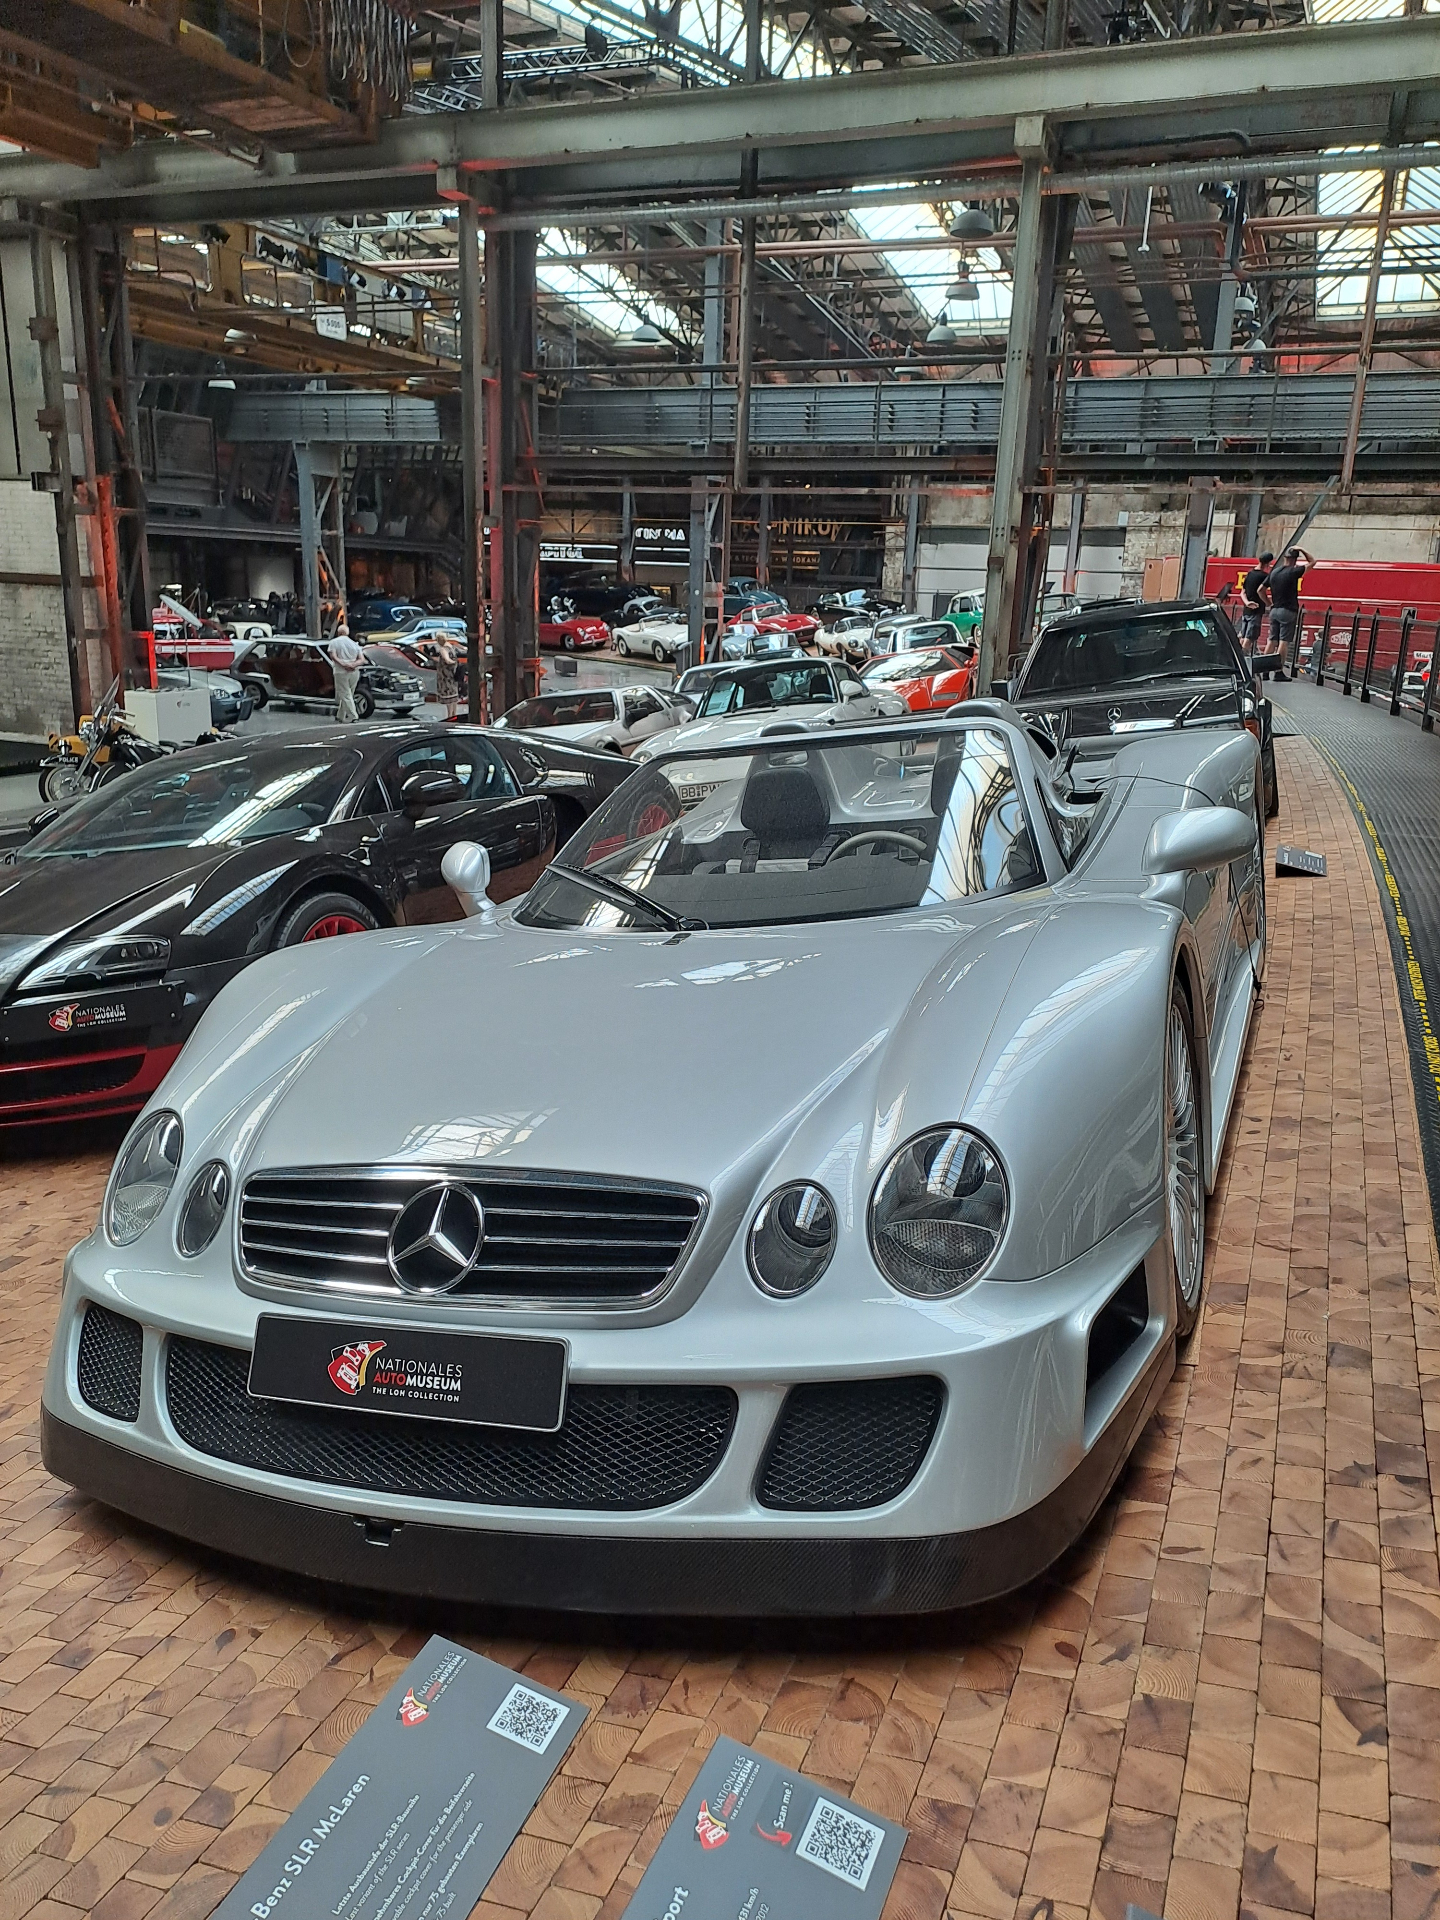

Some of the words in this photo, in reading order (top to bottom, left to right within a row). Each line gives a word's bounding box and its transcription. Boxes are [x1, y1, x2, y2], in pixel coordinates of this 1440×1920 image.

[681, 787, 696, 799] BB
[76, 1004, 125, 1016] NATIONALES
[77, 1011, 126, 1024] AUTOMUSEUM
[98, 1017, 126, 1025] COLLECTION
[373, 1371, 462, 1391] AUTOMUSEUM
[375, 1356, 463, 1378] NATIONALES
[372, 1386, 388, 1396] THE
[389, 1388, 407, 1398] LOH
[408, 1390, 460, 1402] COLLECTION
[417, 1650, 455, 1697] NATIONALES
[425, 1654, 463, 1701] AUTOMUSEUM
[432, 1692, 441, 1703] THE
[447, 1658, 468, 1684] COLLECTION
[711, 1754, 748, 1812] NATIONALES
[721, 1758, 755, 1817] AUTOMUSEUM
[730, 1808, 739, 1820] THE
[742, 1763, 761, 1799] COLLECTION
[284, 1838, 320, 1876] SLR
[312, 1773, 371, 1840] McLaren
[397, 1834, 433, 1884] Cockpit-Cover
[438, 1813, 448, 1826] die
[443, 1772, 476, 1816] Beifahrerseite
[773, 1801, 791, 1829] Scan
[331, 1892, 352, 1916] Letzte
[349, 1849, 382, 1893] Ausbaustufe
[378, 1836, 389, 1852] der
[386, 1794, 420, 1839] SLR-Baureihe
[357, 1884, 376, 1907] variant
[373, 1873, 383, 1885] of
[378, 1863, 389, 1876] the
[385, 1849, 399, 1865] SLR
[397, 1832, 411, 1851] series
[404, 1879, 422, 1904] cockpit
[420, 1861, 433, 1880] cover
[429, 1851, 440, 1863] for
[436, 1840, 447, 1852] the
[445, 1811, 465, 1843] passenger
[463, 1798, 473, 1813] side
[423, 1902, 433, 1917] nur
[428, 1891, 440, 1903] 75
[438, 1861, 459, 1894] gebauten
[455, 1821, 484, 1861] Exemplaren
[436, 1906, 447, 1918] 75
[443, 1892, 457, 1909] built
[655, 1886, 689, 1920] port
[743, 1887, 760, 1910] km/h
